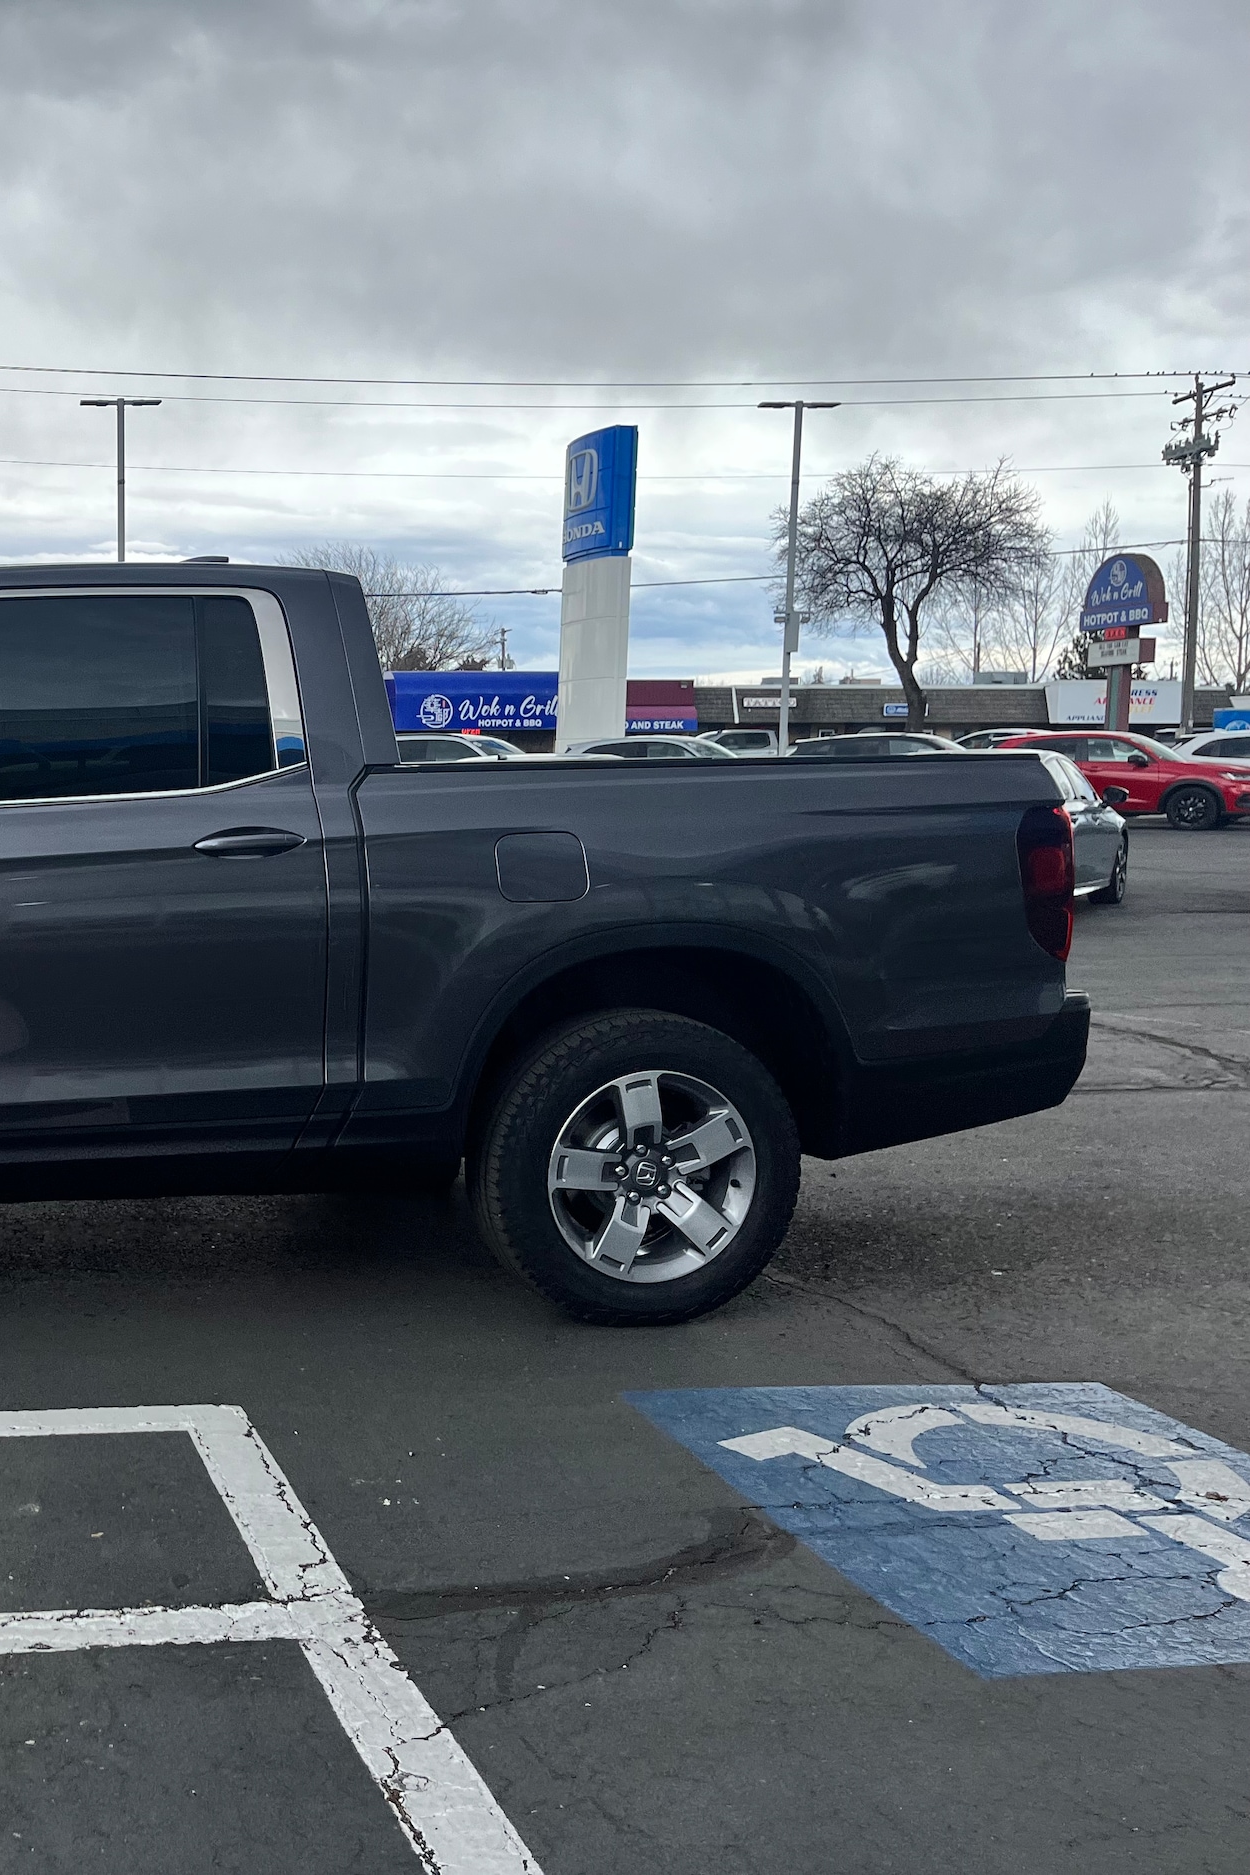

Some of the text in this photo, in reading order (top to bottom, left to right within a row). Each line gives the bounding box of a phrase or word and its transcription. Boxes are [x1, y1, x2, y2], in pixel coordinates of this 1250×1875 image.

[1084, 608, 1148, 626] HOTPOT & BBQ
[459, 695, 501, 720] Wok
[505, 704, 515, 716] n
[745, 699, 795, 707] TATTO
[478, 719, 542, 727] HOTPOT & BBQ
[631, 721, 651, 730] AND
[653, 720, 684, 730] STEAK
